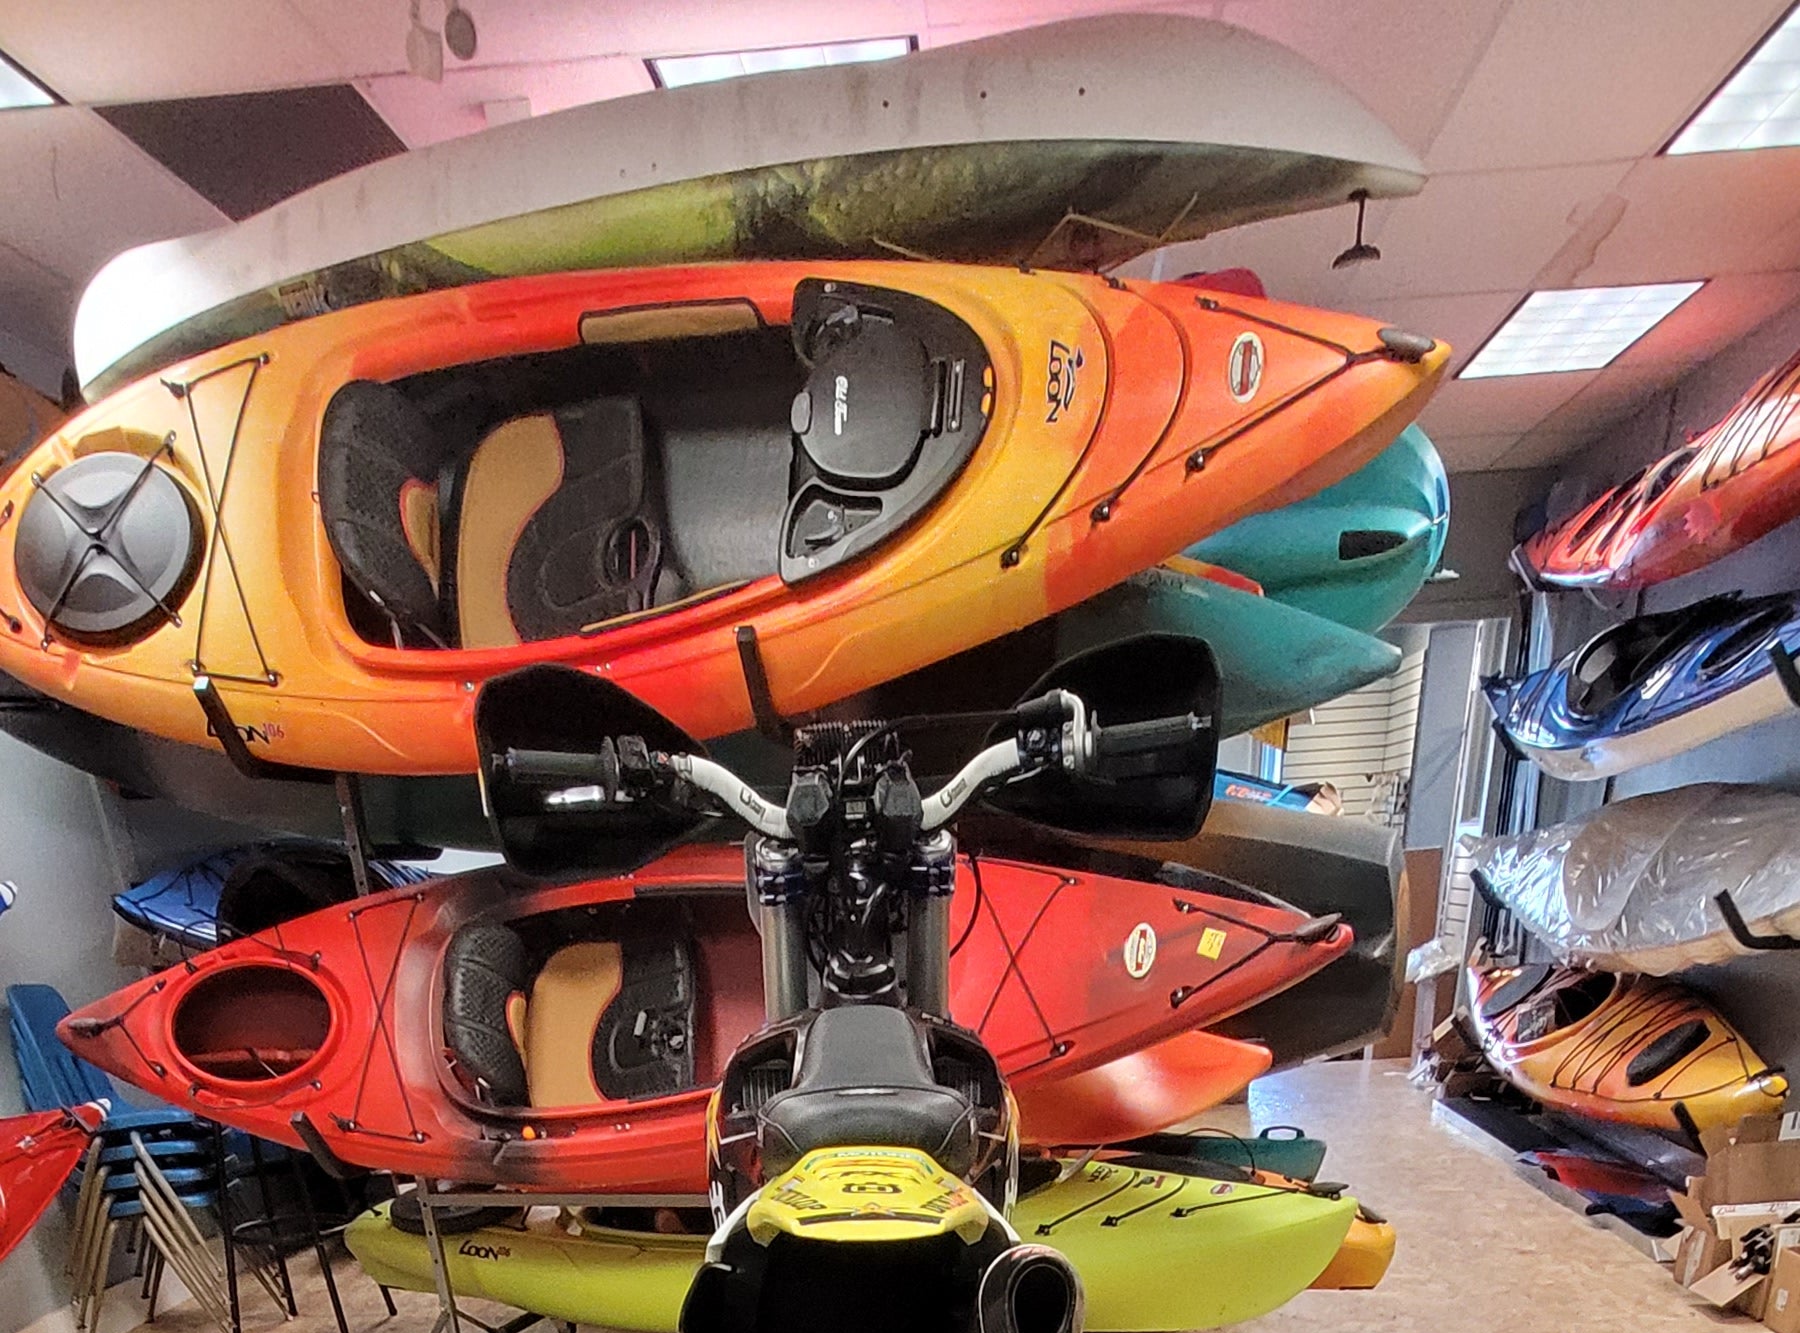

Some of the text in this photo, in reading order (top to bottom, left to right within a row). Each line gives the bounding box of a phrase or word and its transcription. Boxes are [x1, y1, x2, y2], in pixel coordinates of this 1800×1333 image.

[1046, 340, 1070, 423] LOON
[207, 718, 270, 745] LON
[459, 1240, 498, 1261] LOON
